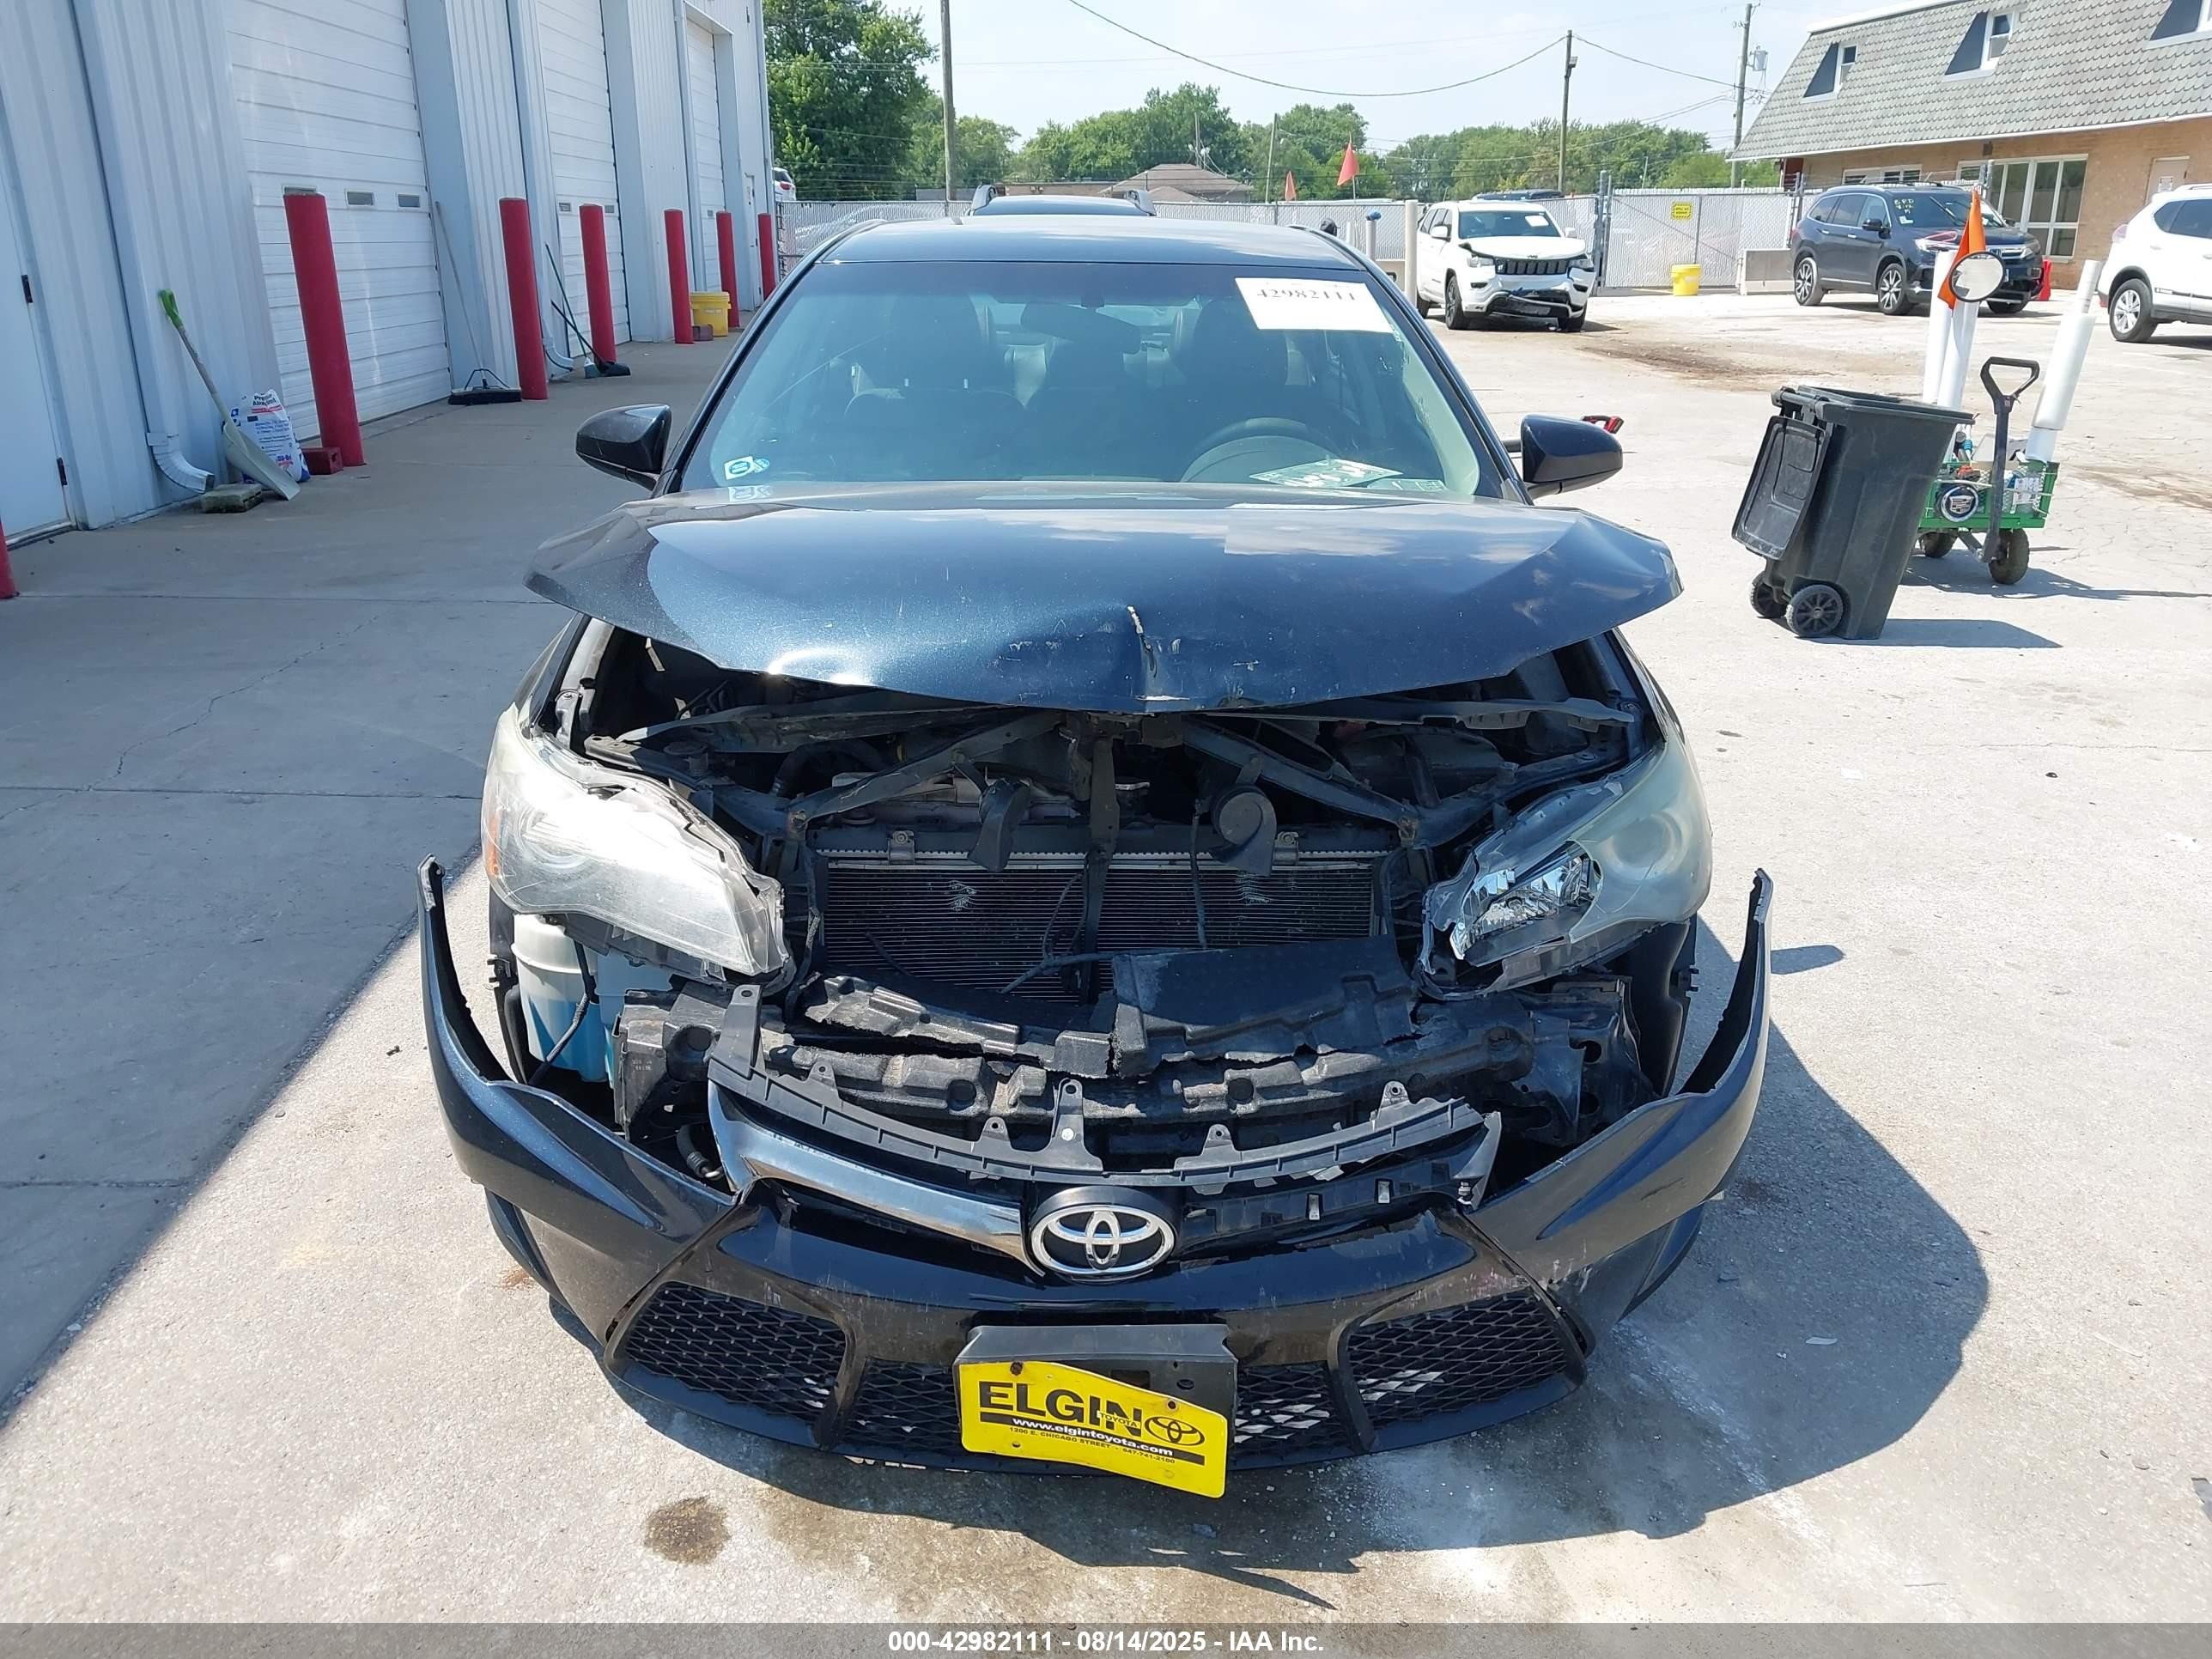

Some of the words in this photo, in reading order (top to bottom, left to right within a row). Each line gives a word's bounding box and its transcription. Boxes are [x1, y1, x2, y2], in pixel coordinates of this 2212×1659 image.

[979, 1381, 1142, 1437] ELGIN
[1099, 1412, 1138, 1428] TOYOTA
[1012, 1418, 1173, 1457] www.elgintoyota.com
[1041, 1431, 1078, 1443] CHICAGO
[1079, 1438, 1110, 1449] STREET
